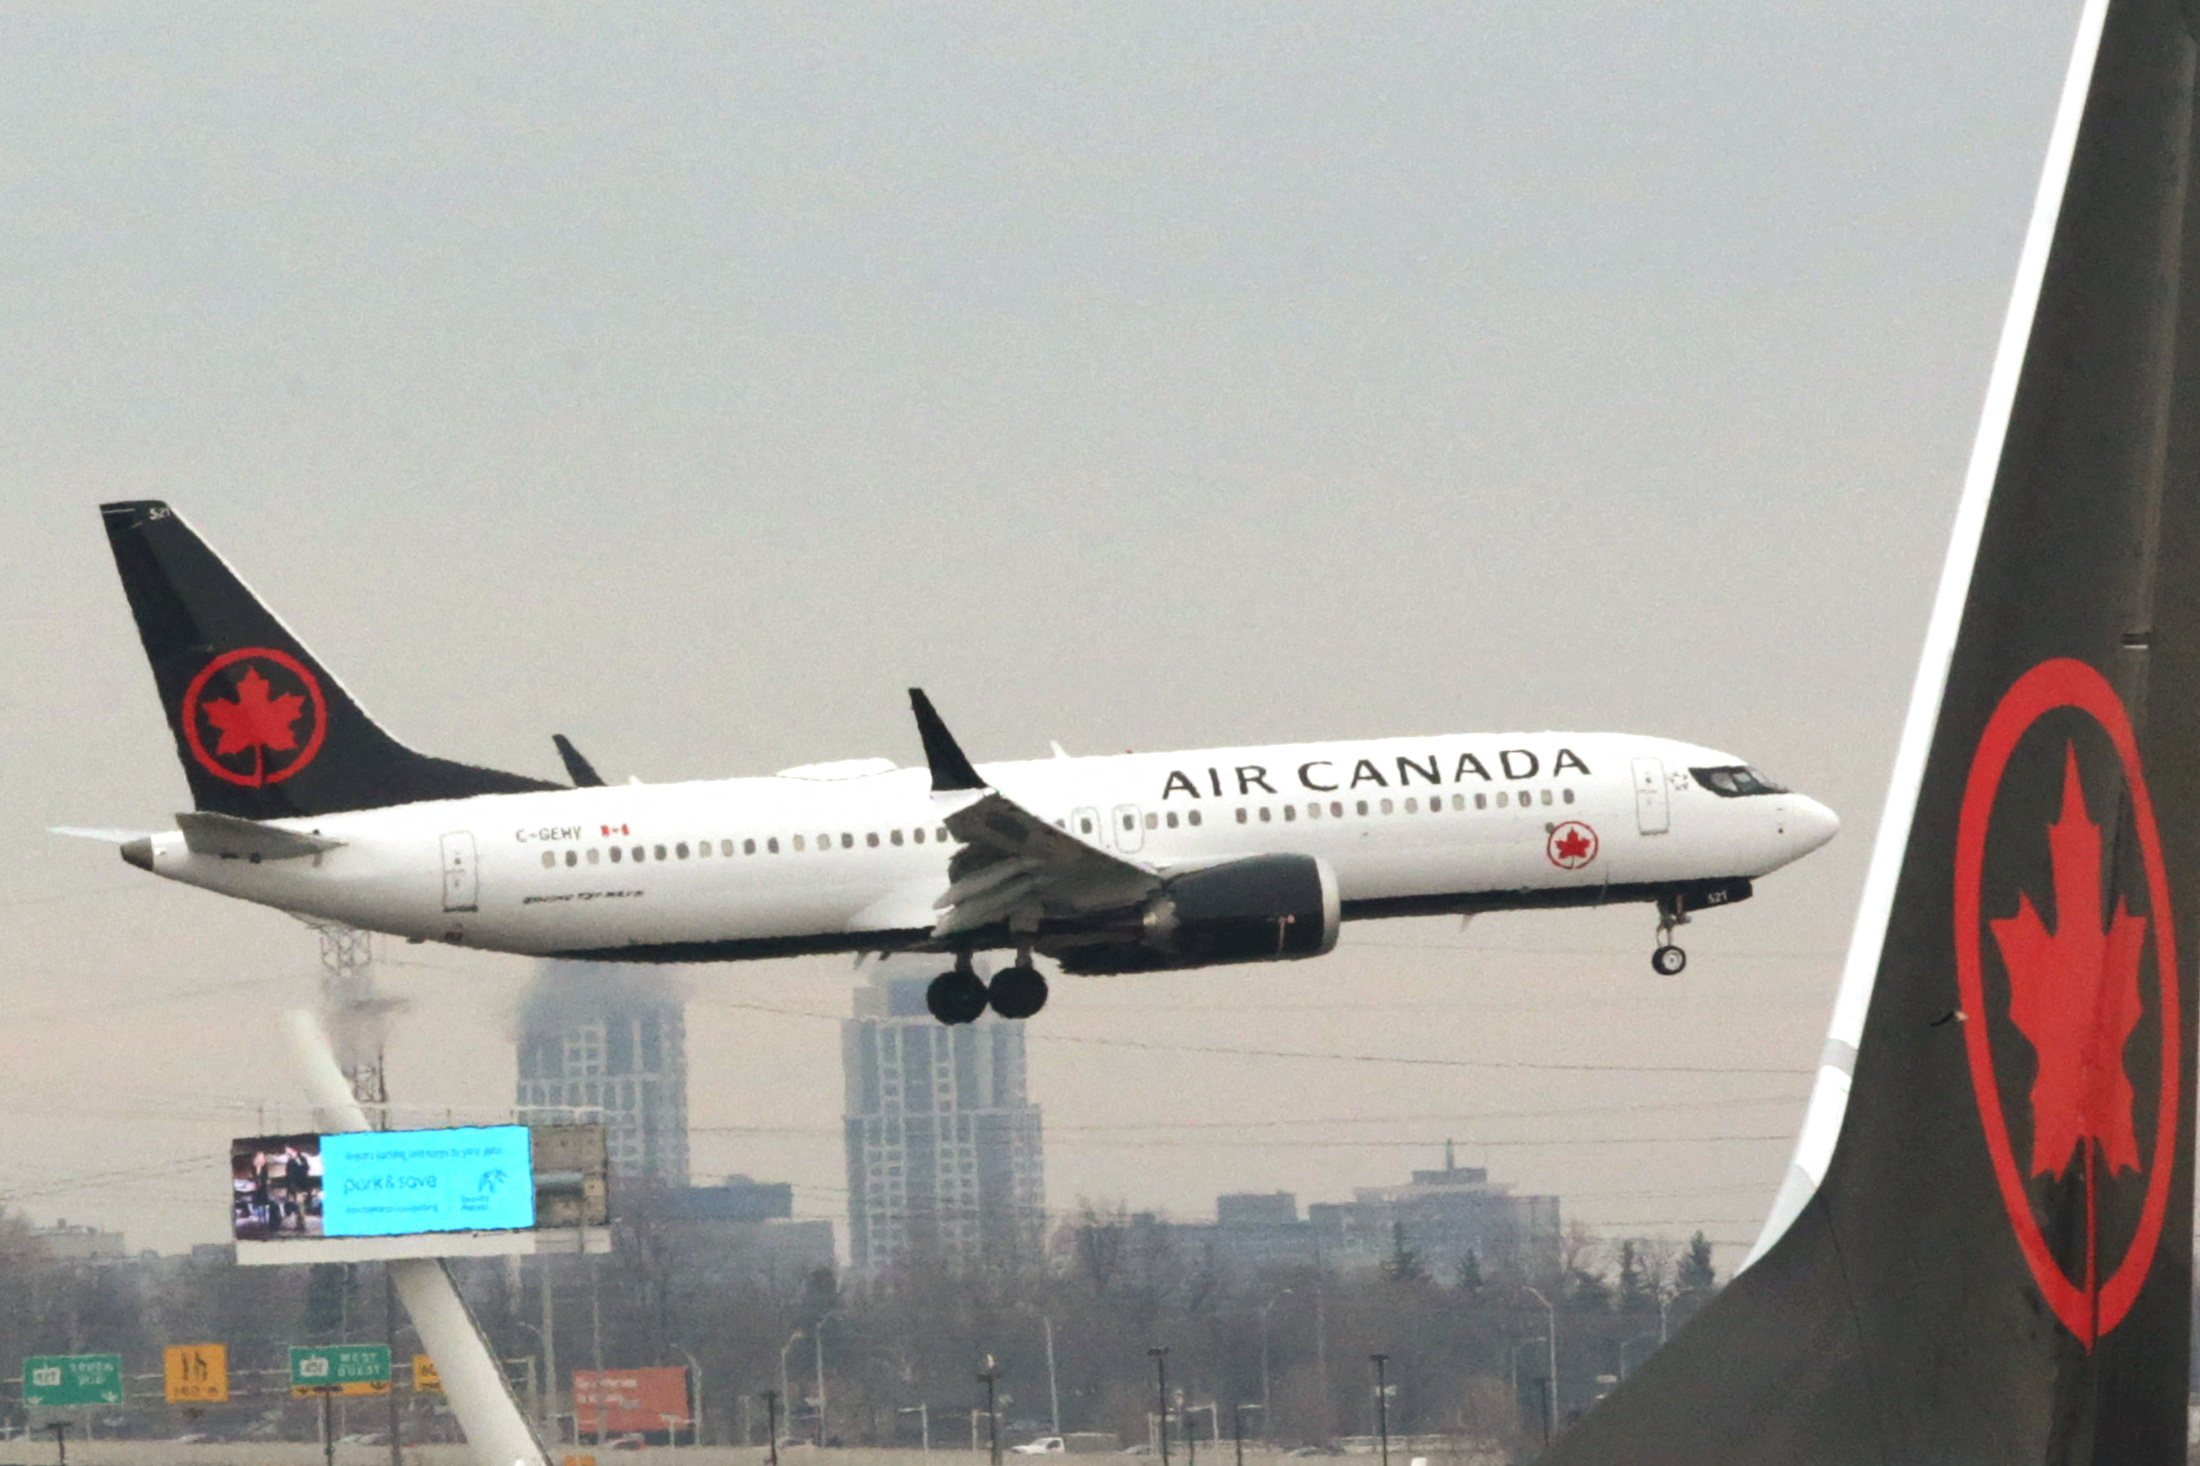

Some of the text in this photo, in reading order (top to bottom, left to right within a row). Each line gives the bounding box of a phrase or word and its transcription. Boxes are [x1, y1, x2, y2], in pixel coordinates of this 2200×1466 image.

[1162, 748, 1592, 800] AIR CANADA
[1707, 889, 1728, 904] 521
